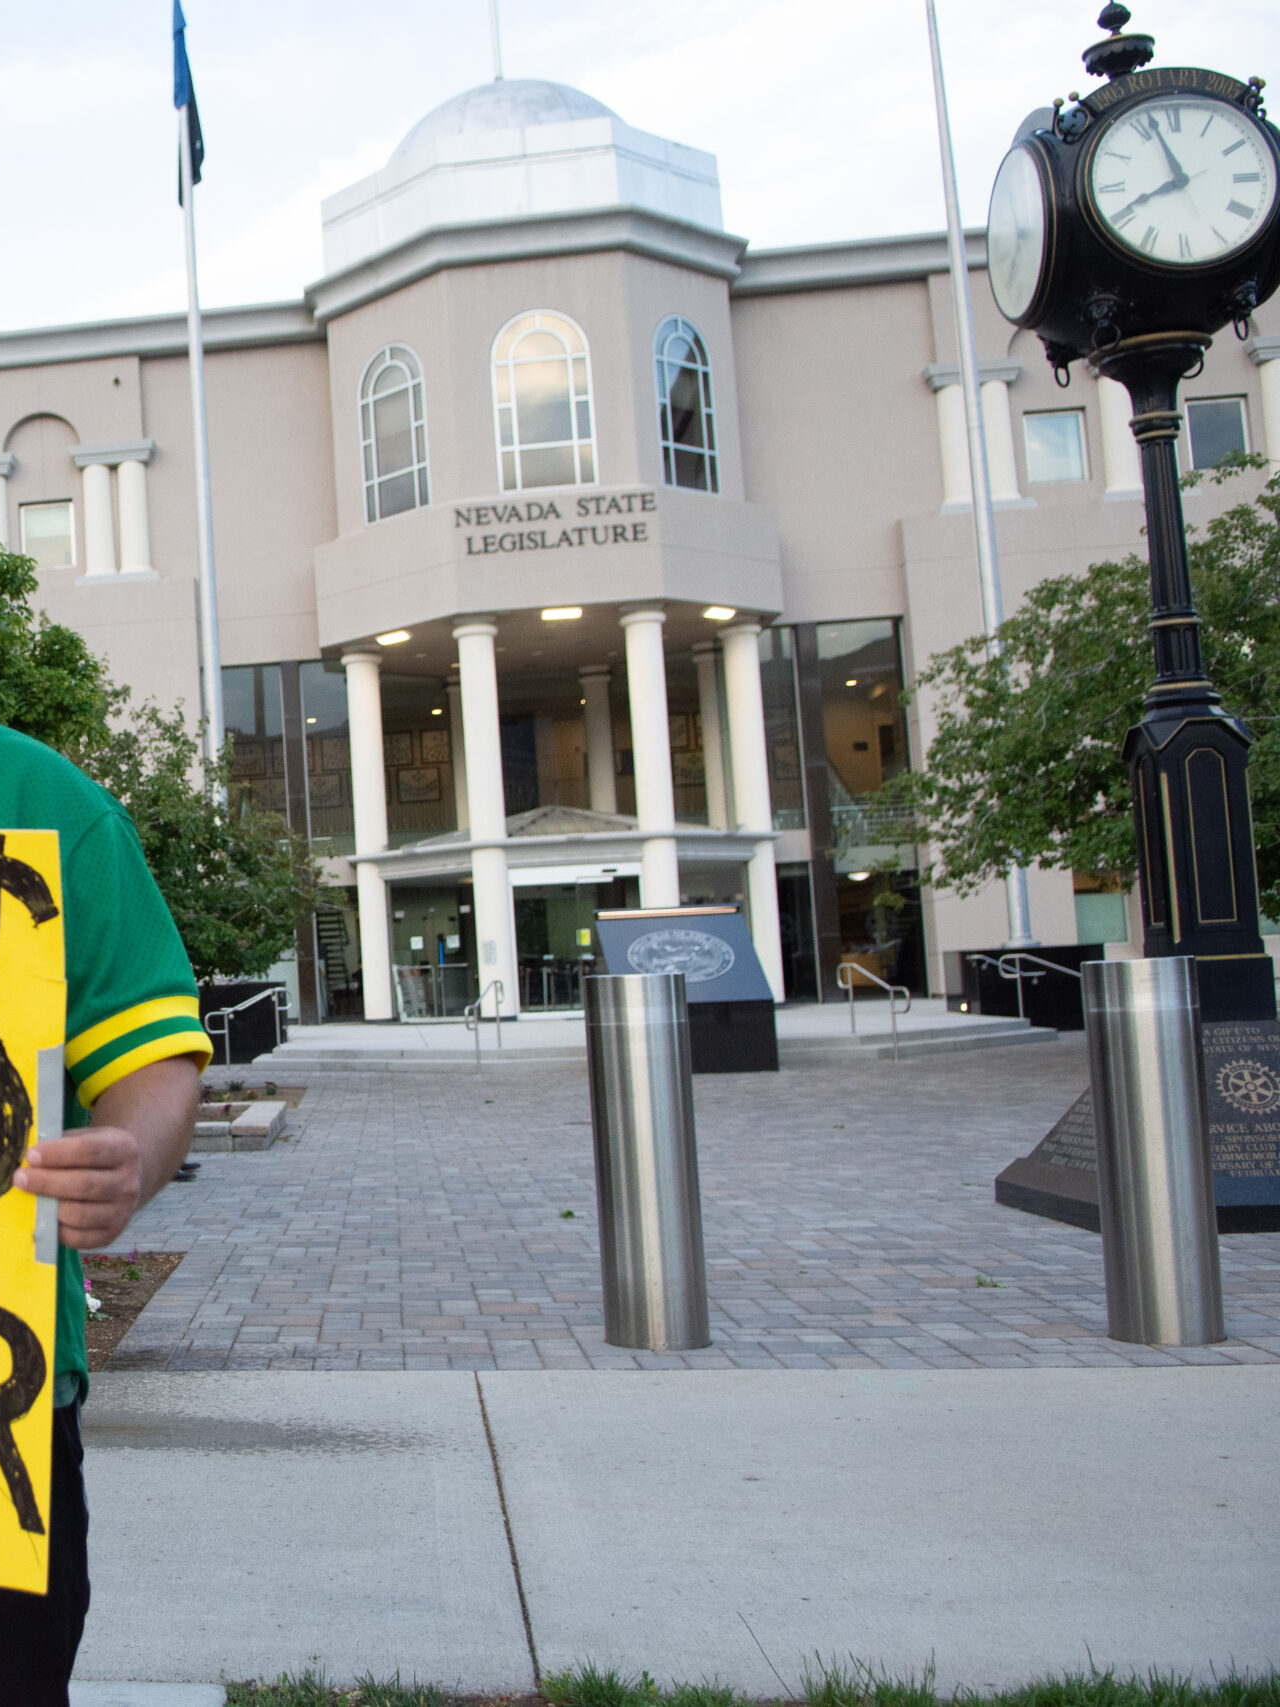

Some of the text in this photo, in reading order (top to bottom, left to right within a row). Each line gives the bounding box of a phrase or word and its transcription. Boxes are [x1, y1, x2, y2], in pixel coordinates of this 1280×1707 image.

[1091, 69, 1243, 110] 1905 ROTARY 2005
[455, 492, 657, 528] NEVADA STATE
[466, 522, 649, 556] LEGISLATURE
